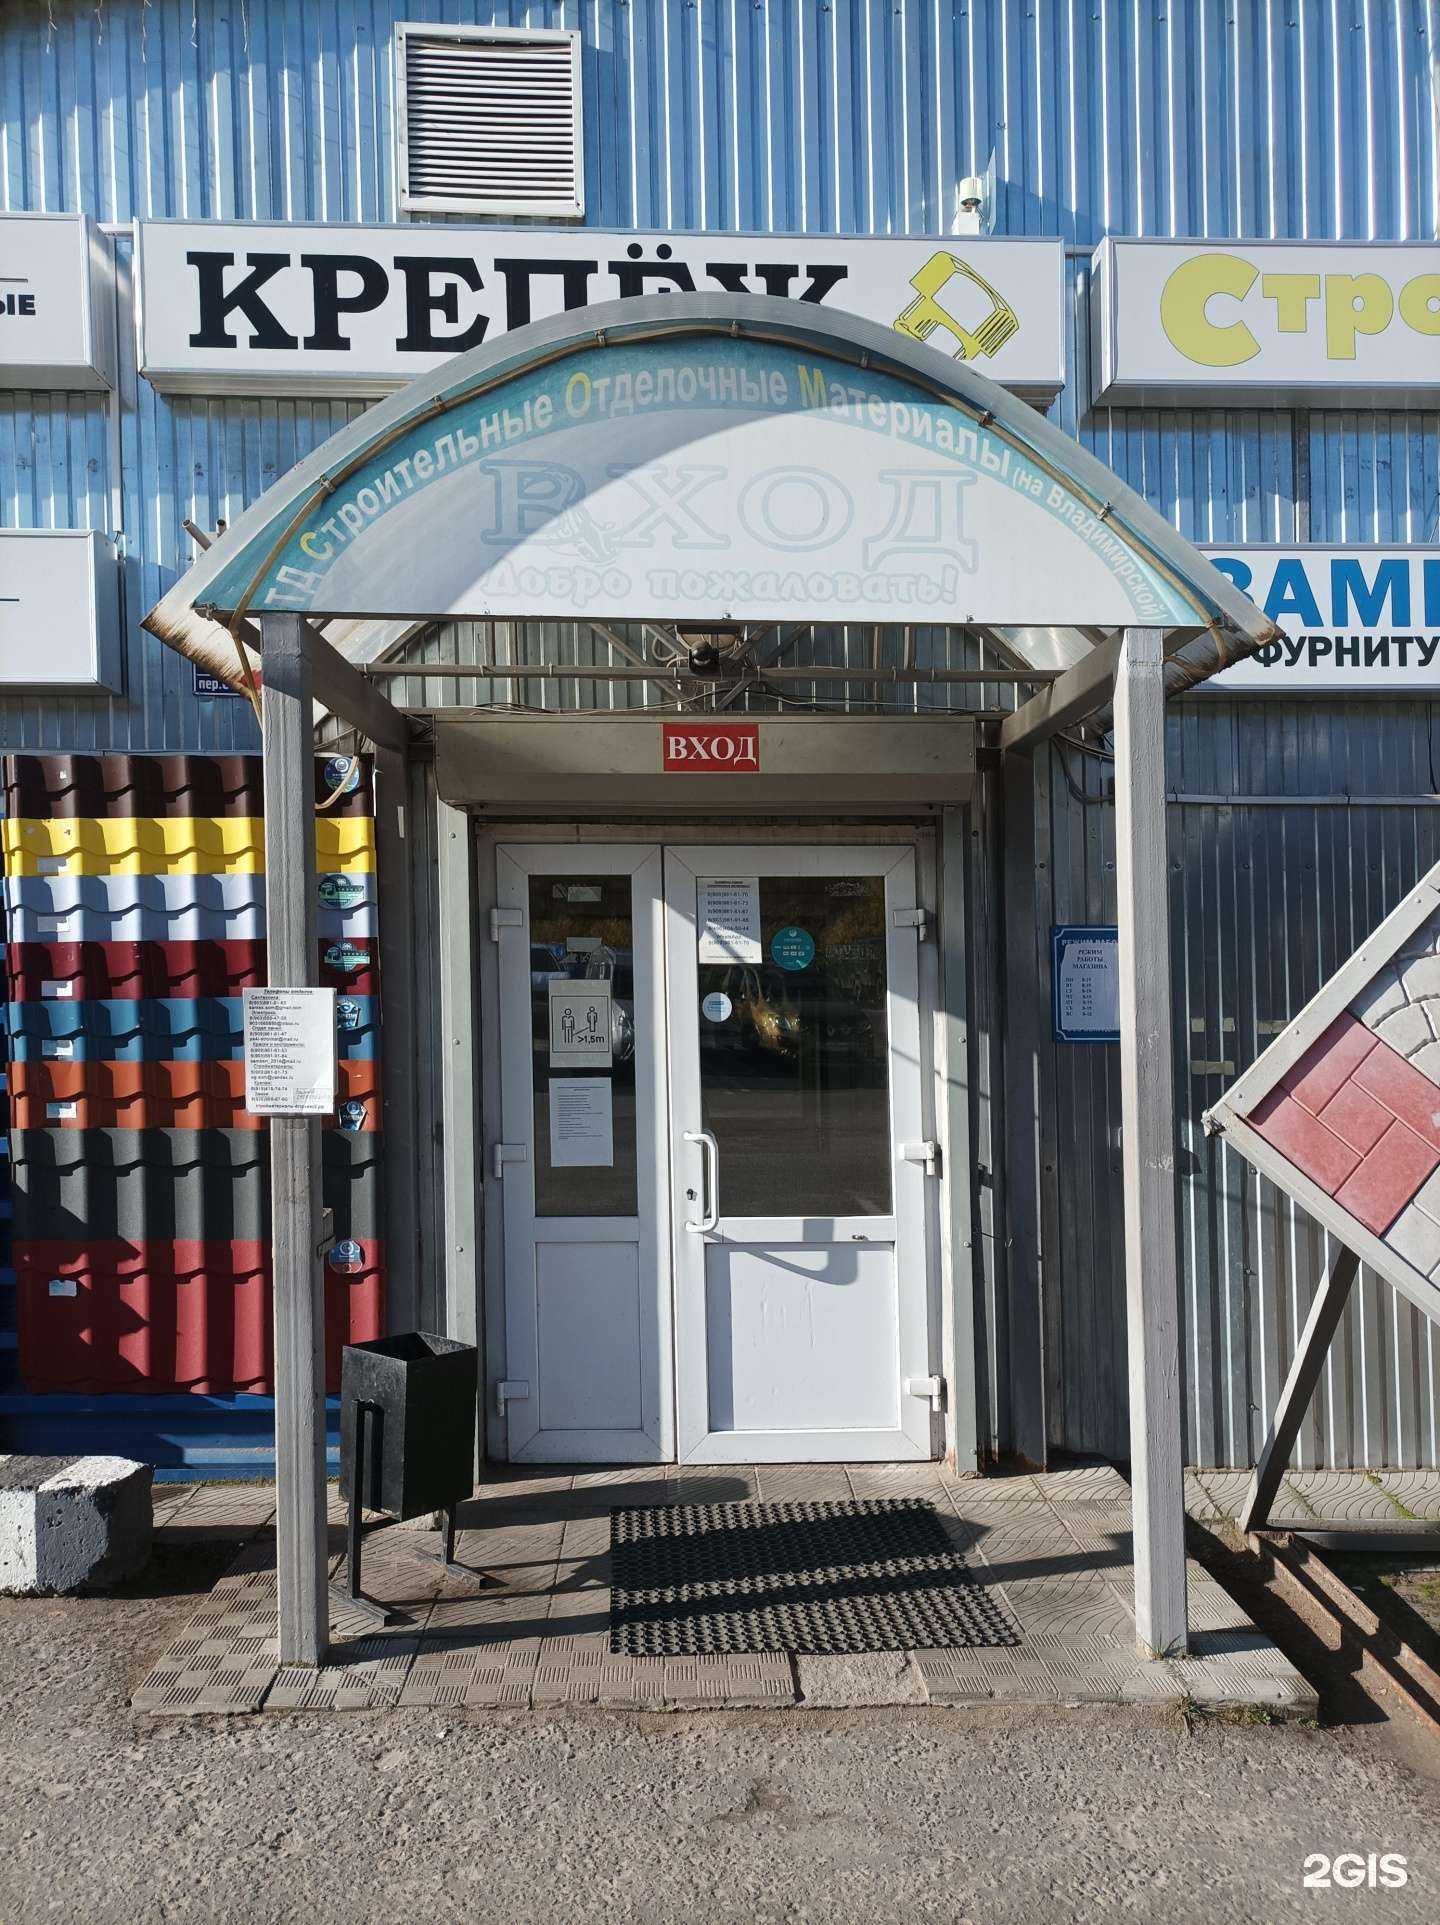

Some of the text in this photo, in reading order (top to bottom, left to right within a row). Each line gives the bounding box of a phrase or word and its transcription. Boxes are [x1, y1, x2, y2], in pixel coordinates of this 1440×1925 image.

[1160, 253, 1440, 367] Стро
[264, 565, 321, 604] ТД
[301, 394, 553, 560] Строительные
[566, 366, 788, 419] Отделочные
[798, 365, 1011, 478] Материалы
[1013, 466, 1042, 498] (на
[480, 459, 979, 574] ВХОД
[481, 560, 958, 607] Добро пожаловать!
[1210, 557, 1440, 628] АМ
[667, 736, 757, 766] ВХОД
